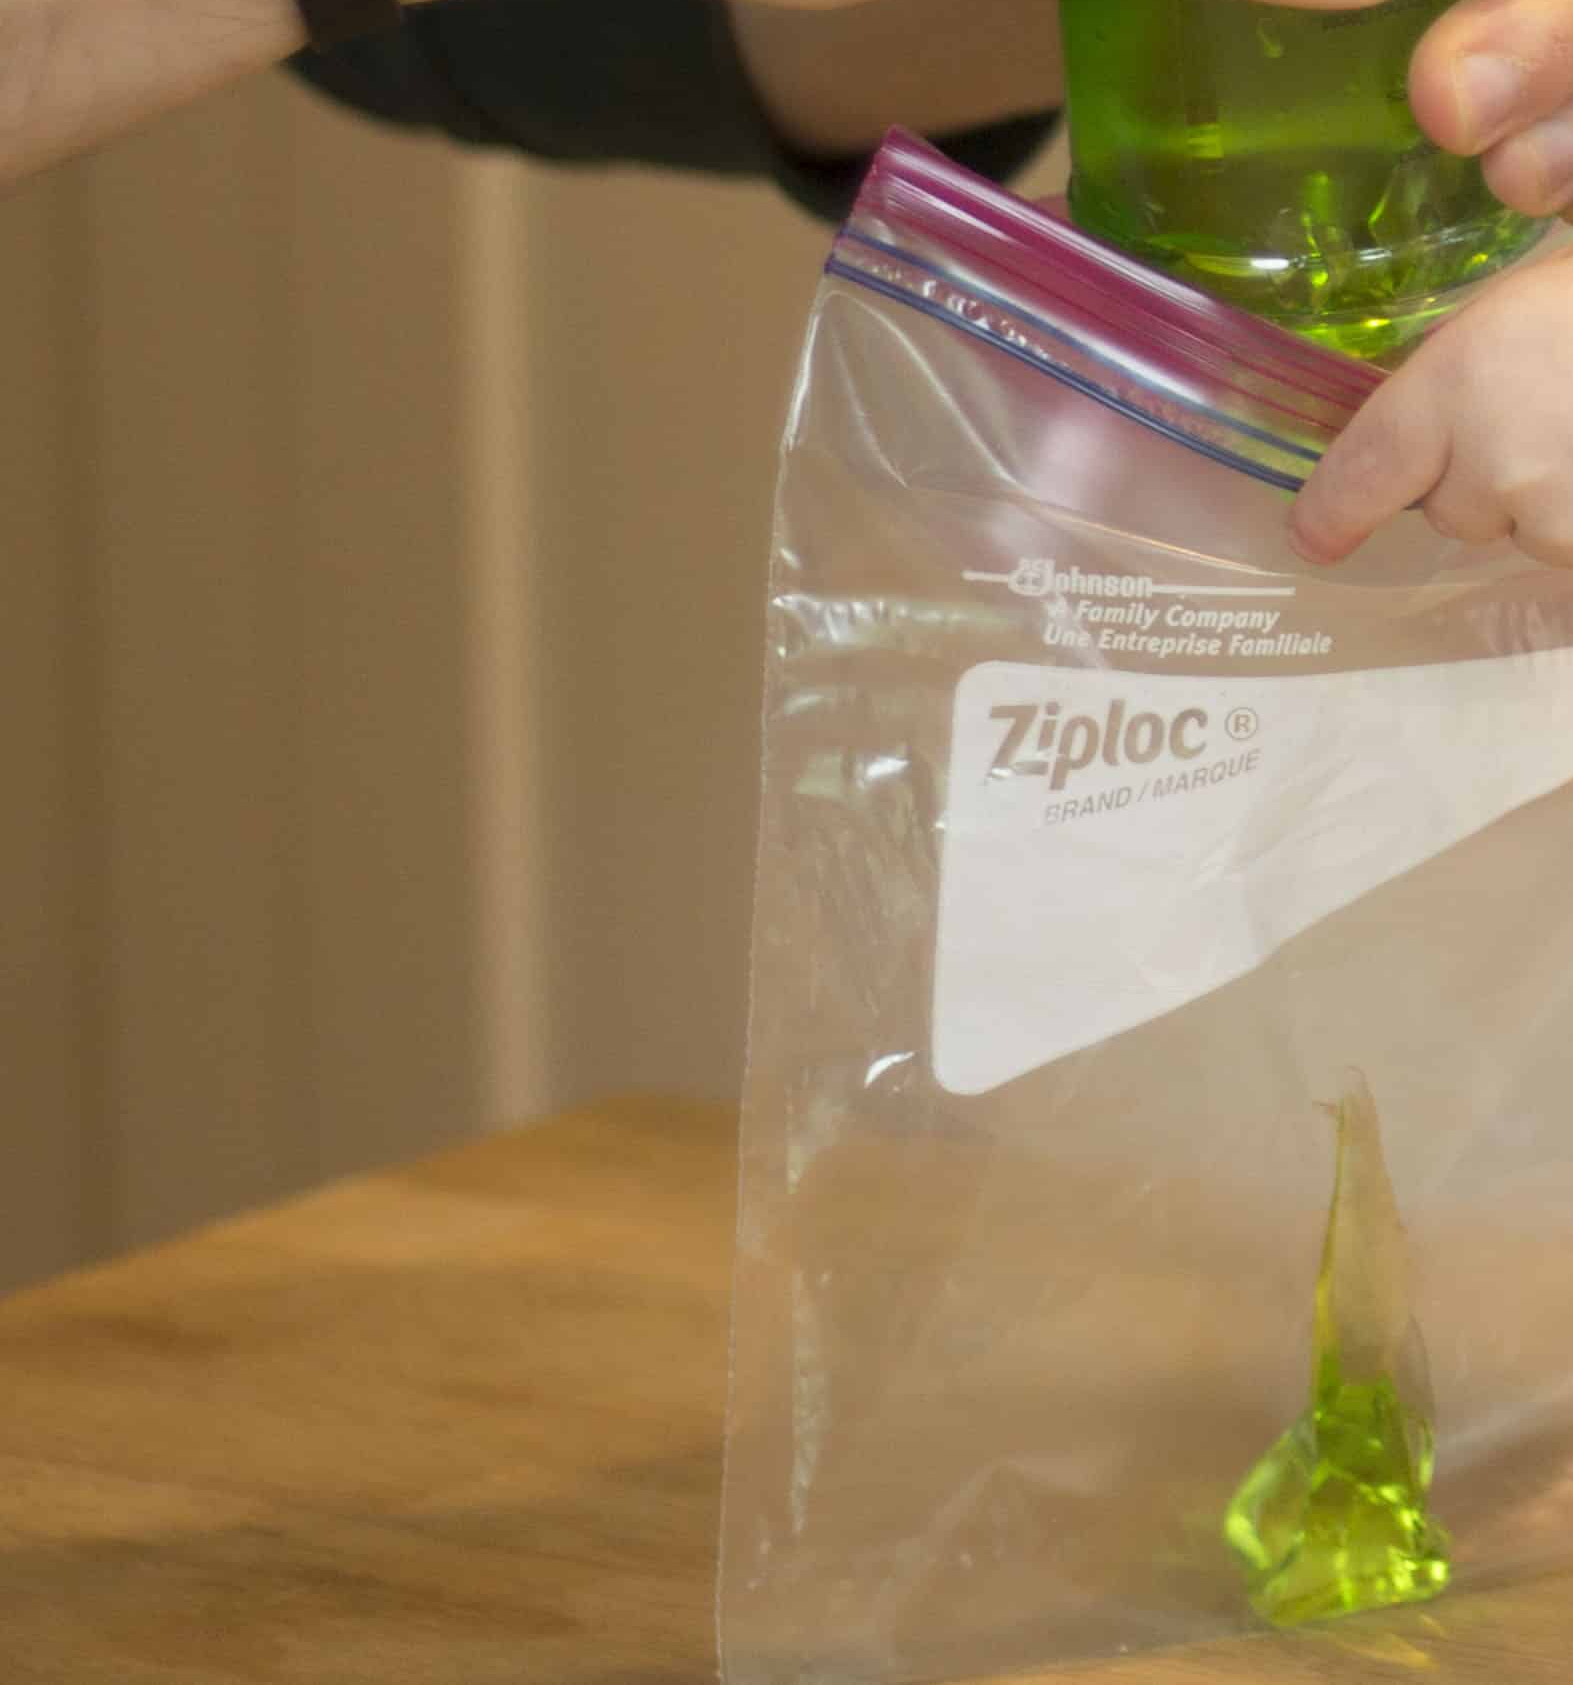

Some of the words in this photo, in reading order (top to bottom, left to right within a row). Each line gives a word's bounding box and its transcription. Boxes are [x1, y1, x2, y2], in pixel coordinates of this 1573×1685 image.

[1074, 599, 1160, 631] Family
[1166, 603, 1281, 635] Company
[1043, 622, 1090, 648] Une
[1099, 628, 1222, 659] Entreprise
[1228, 631, 1333, 657] Familiale
[981, 698, 1209, 792] Ziploc
[1151, 747, 1262, 799] MARQUE
